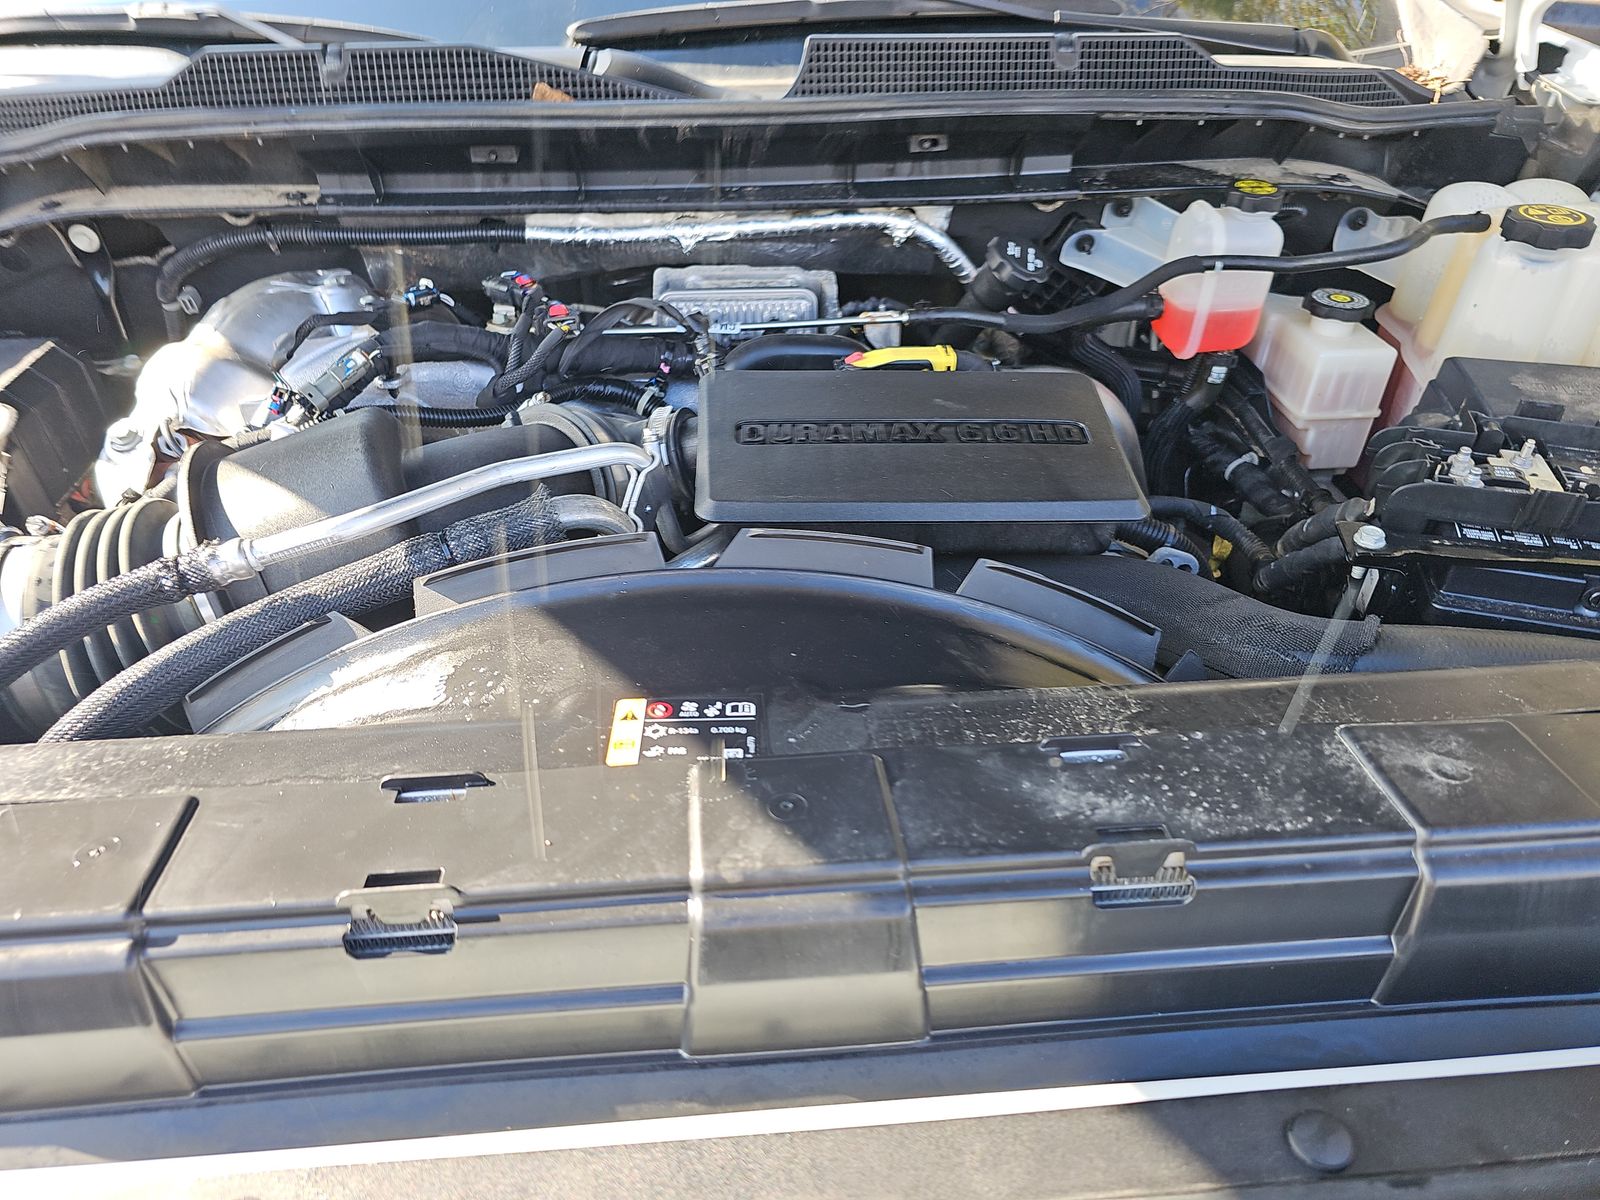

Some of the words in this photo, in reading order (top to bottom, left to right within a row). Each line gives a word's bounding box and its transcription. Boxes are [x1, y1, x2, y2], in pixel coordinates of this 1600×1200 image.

[740, 422, 944, 443] DURAMAX
[956, 423, 1018, 443] 6.6
[1027, 423, 1085, 443] HD
